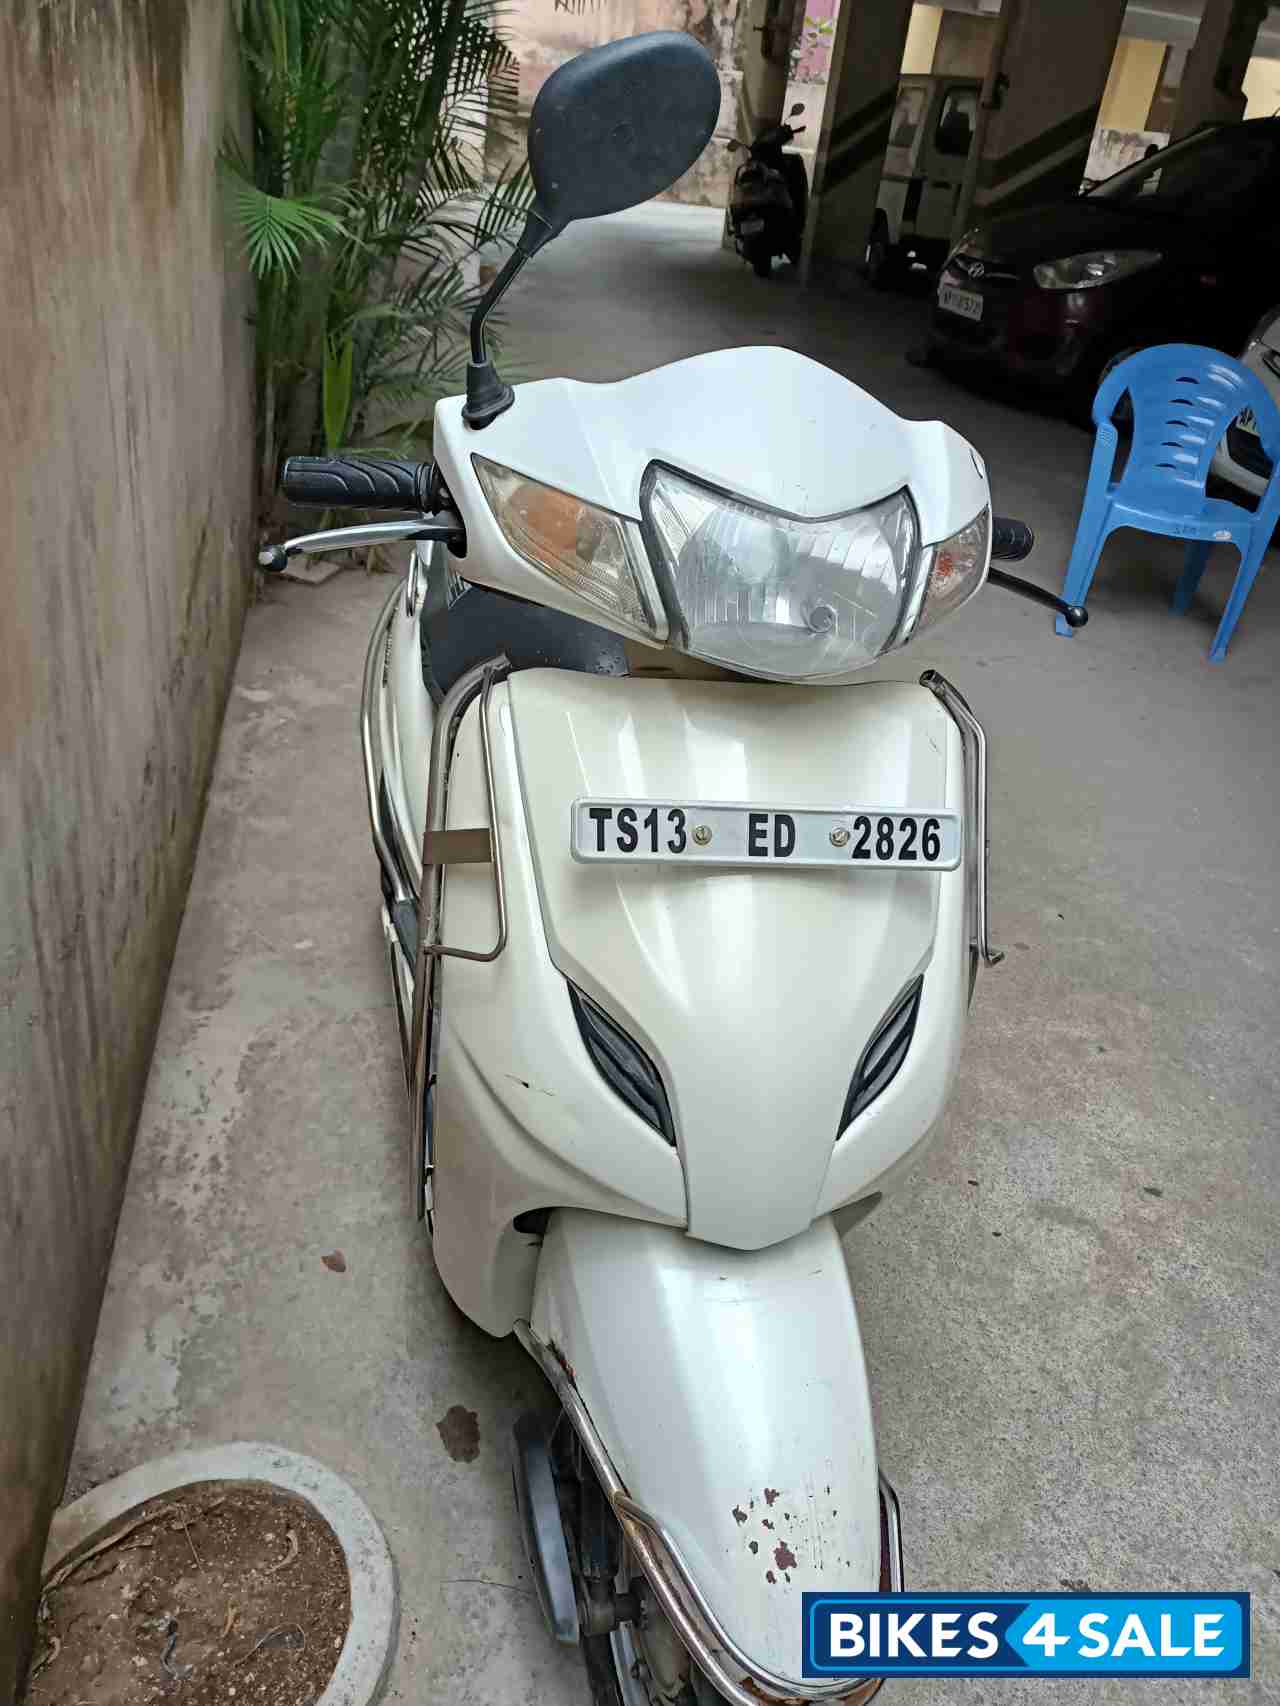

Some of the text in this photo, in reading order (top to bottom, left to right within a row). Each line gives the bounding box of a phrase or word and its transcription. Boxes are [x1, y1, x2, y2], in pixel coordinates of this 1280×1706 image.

[590, 808, 941, 863] TS13 ED 2826
